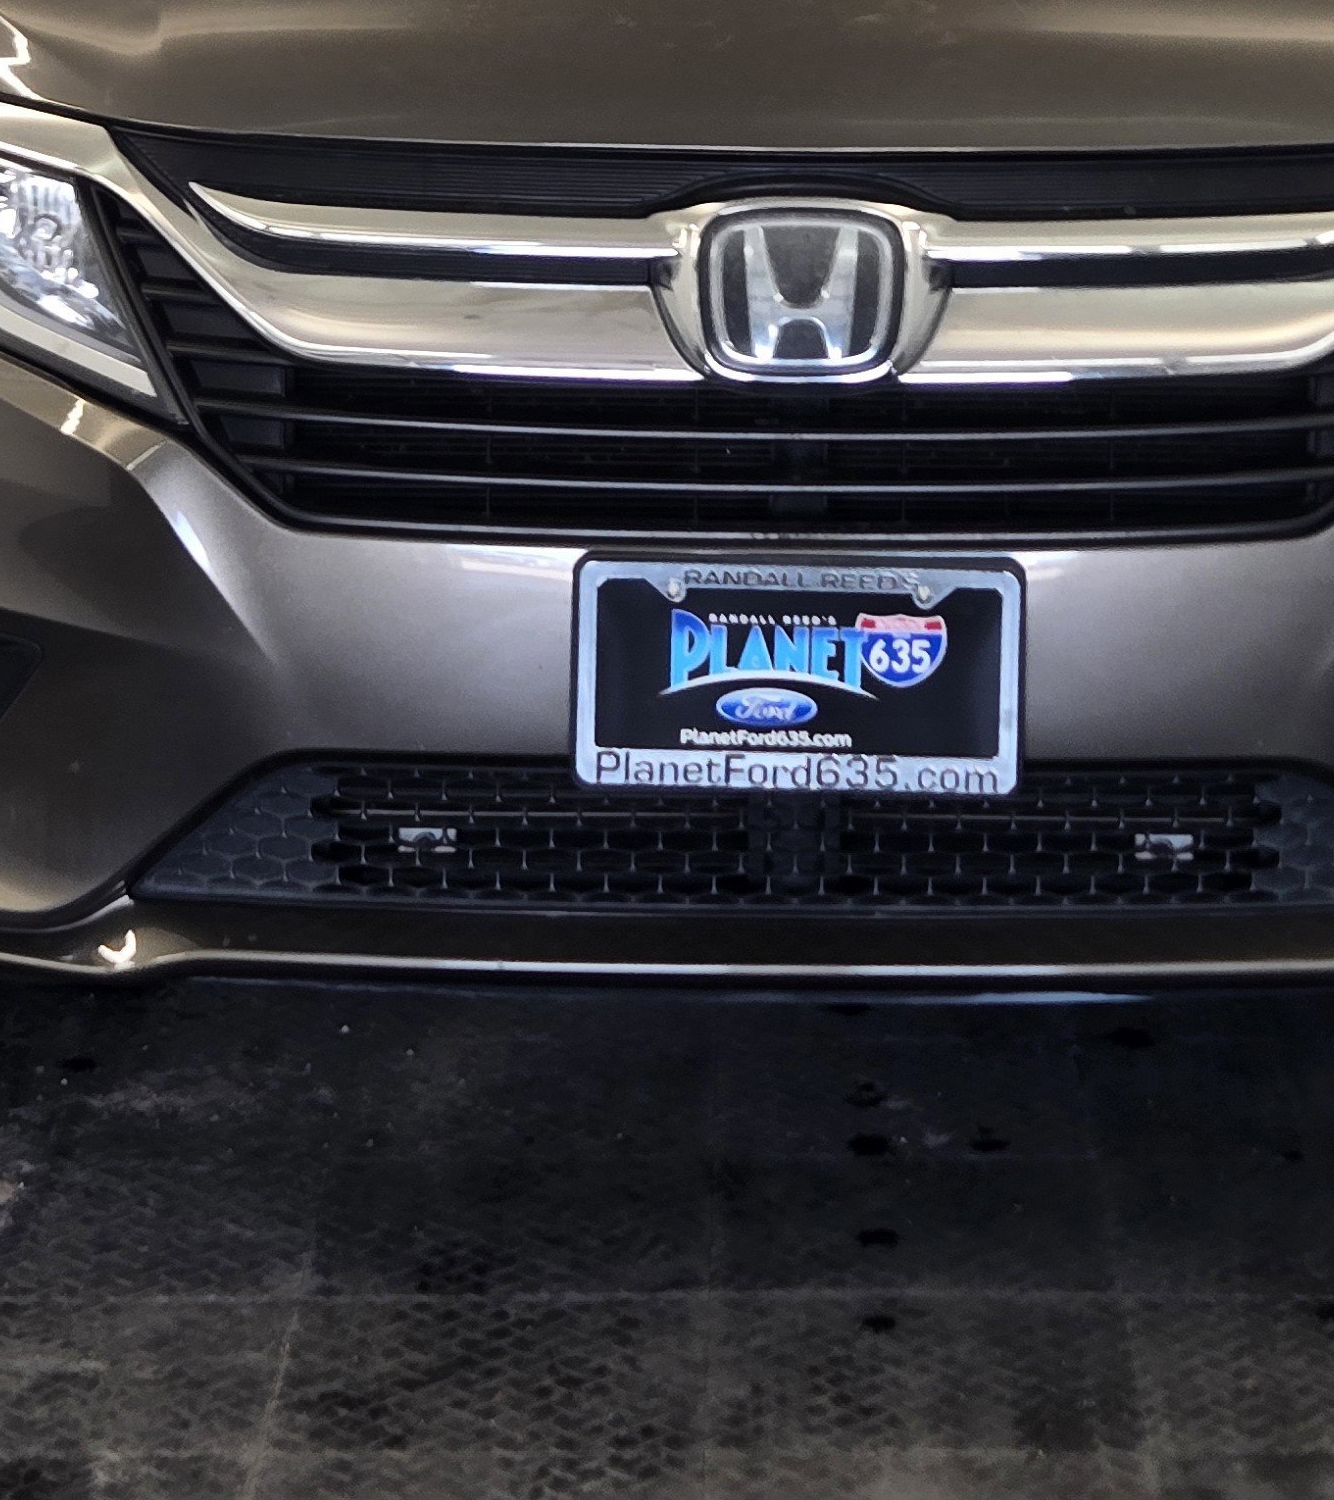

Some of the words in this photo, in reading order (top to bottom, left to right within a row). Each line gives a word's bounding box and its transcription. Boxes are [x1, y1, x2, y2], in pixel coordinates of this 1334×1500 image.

[683, 569, 811, 588] RANDALL
[670, 608, 866, 690] PLANET
[869, 637, 932, 674] 635
[732, 692, 802, 722] Ford
[679, 727, 853, 748] PlanetFord635.com
[595, 750, 1000, 794] PlanetFord635.com
